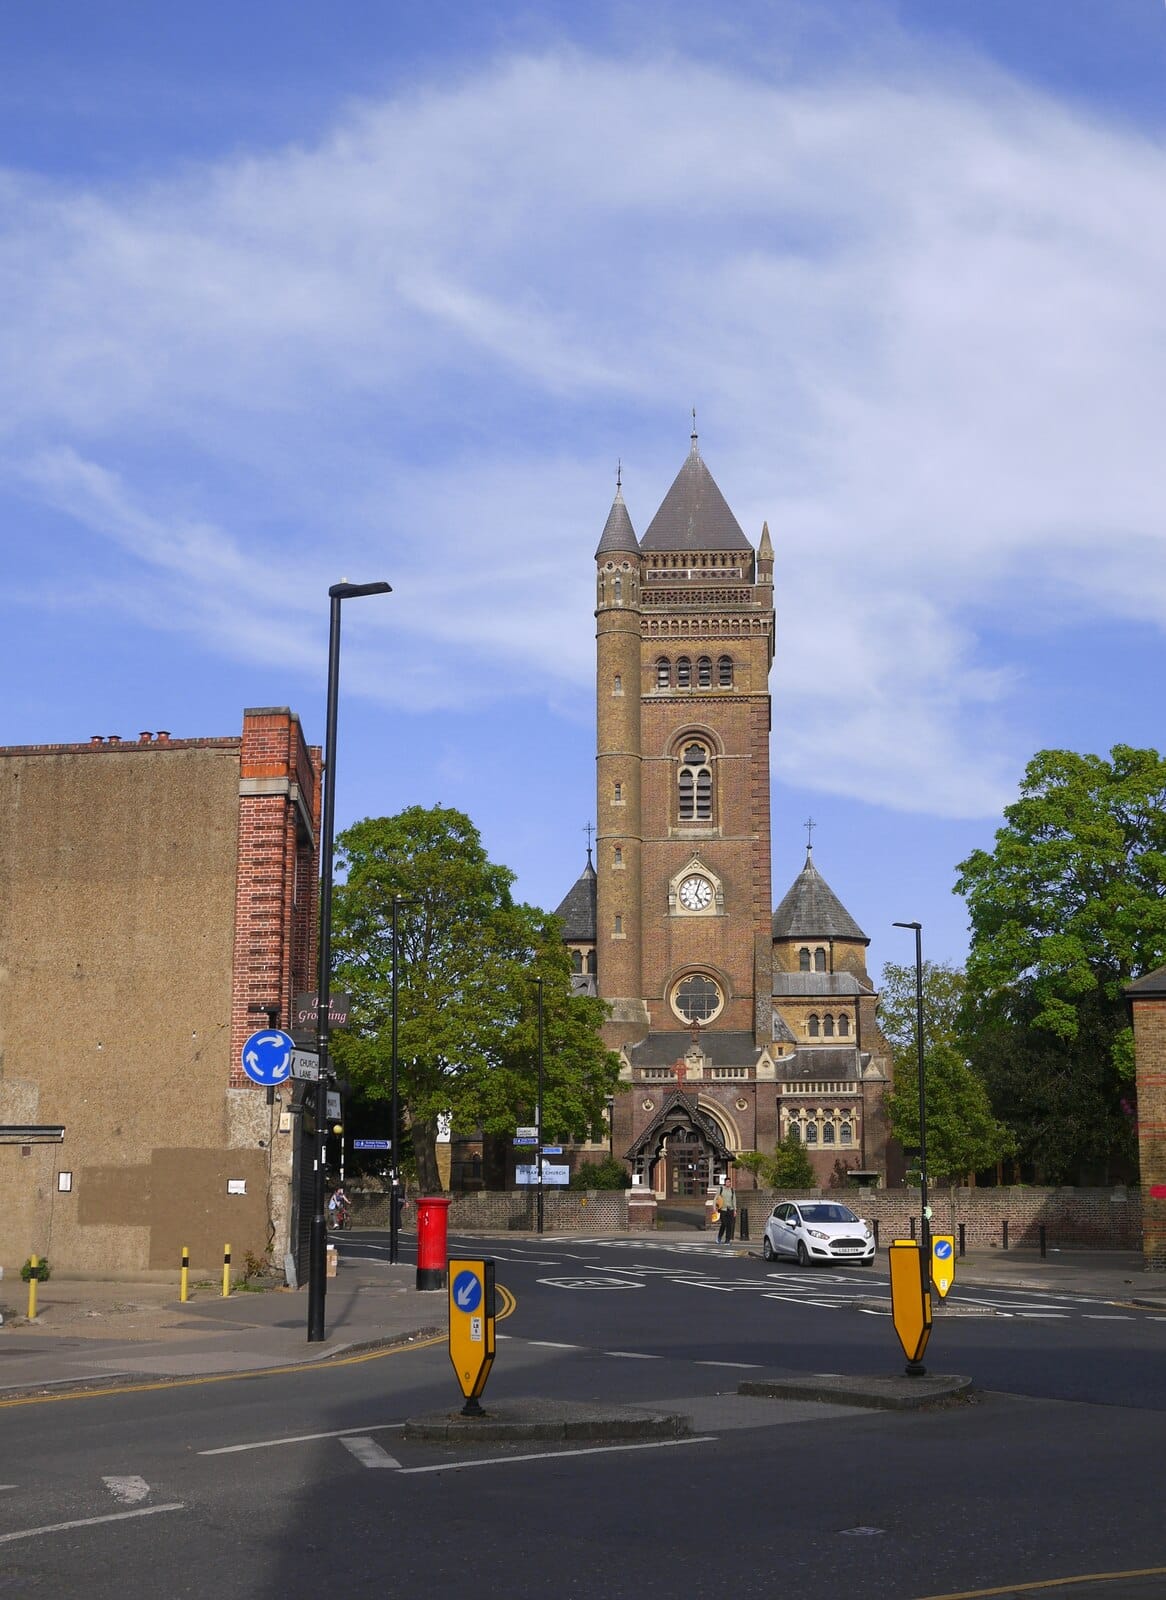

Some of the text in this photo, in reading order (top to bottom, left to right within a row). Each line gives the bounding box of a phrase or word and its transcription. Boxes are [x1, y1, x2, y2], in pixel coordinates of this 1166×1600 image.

[311, 997, 334, 1009] Pt
[298, 1010, 347, 1024] Groing
[300, 1058, 318, 1069] CHURCH
[300, 1070, 312, 1080] LANE
